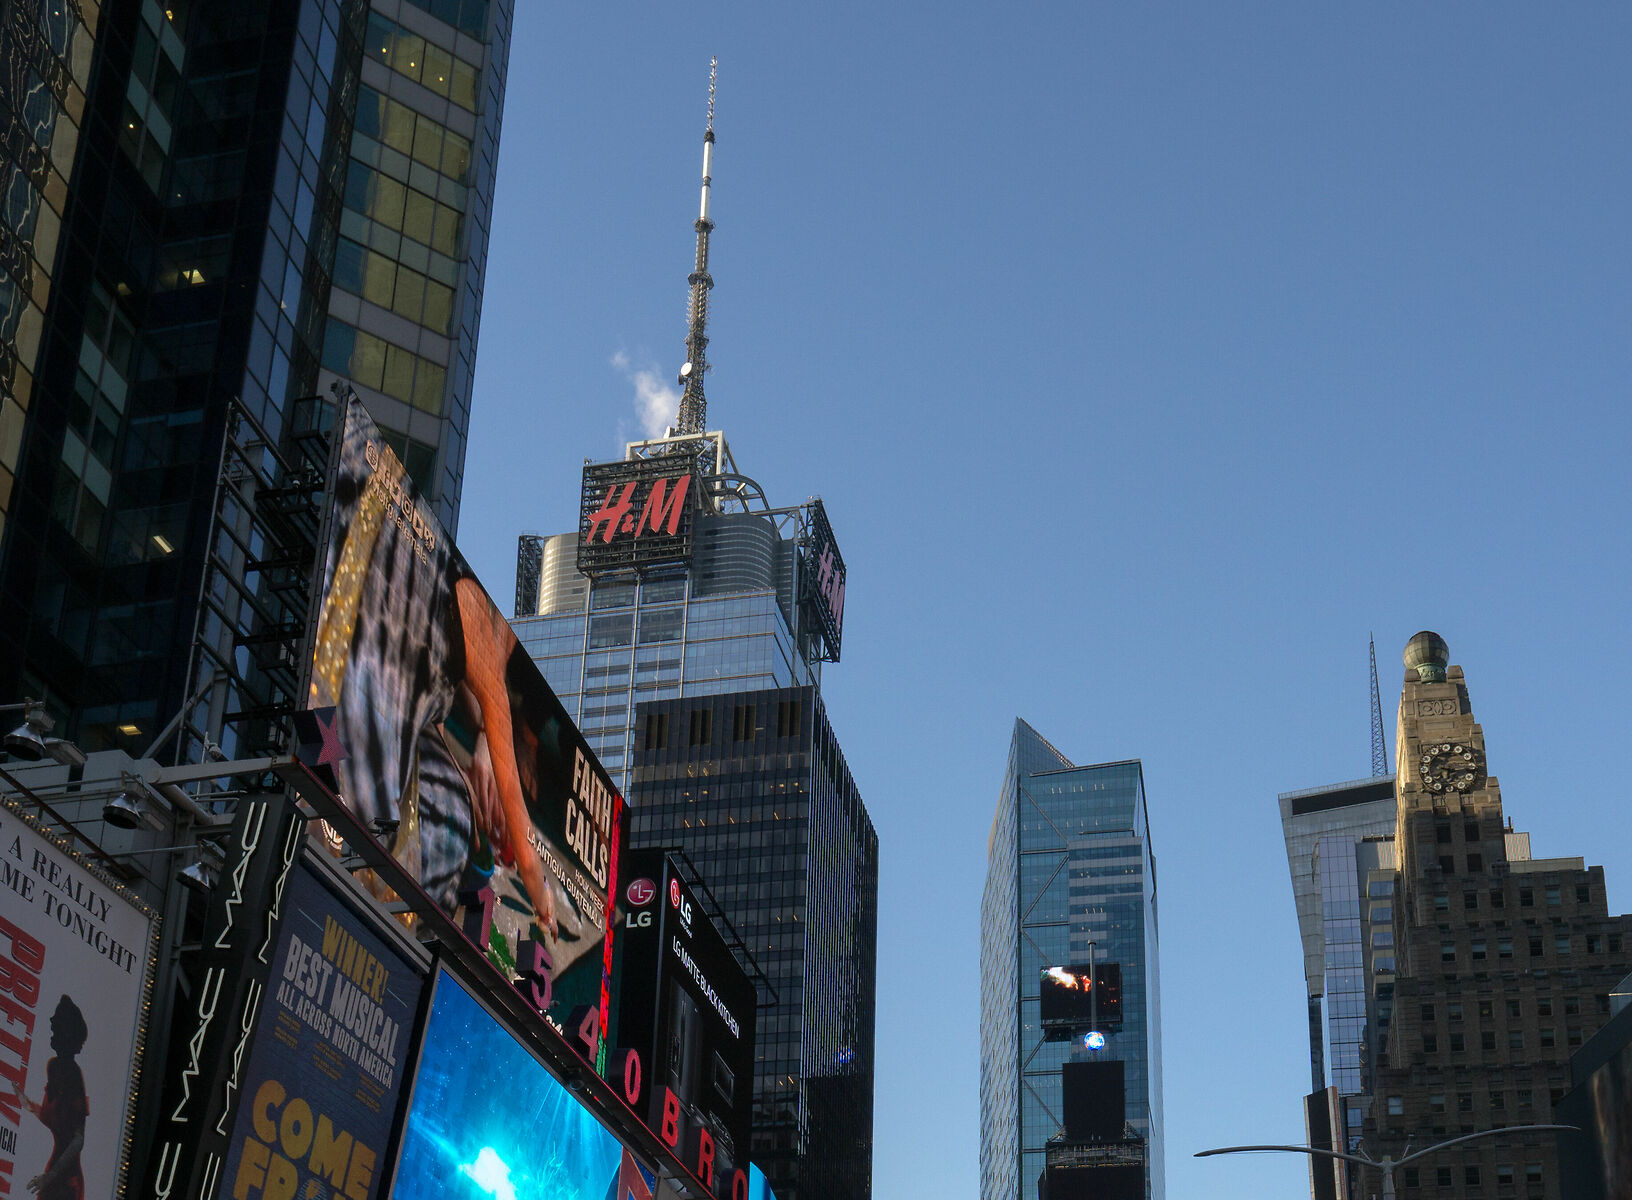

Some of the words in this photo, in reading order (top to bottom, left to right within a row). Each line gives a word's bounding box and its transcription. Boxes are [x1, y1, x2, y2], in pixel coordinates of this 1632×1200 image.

[586, 474, 691, 544] H&M
[817, 541, 845, 634] H&M
[573, 745, 612, 838] FAITH
[8, 835, 23, 862] A
[32, 848, 112, 923] REALLY
[526, 827, 537, 846] LA
[536, 841, 567, 888] ANTIGUA
[566, 879, 603, 932] GUATEMALA
[565, 797, 608, 890] CALLS
[43, 890, 137, 974] TONIGHT
[575, 869, 590, 894] HOLY
[589, 889, 605, 916] WEEK
[626, 911, 651, 929] LG
[680, 894, 692, 925] LG
[283, 934, 333, 1006] BEST
[329, 974, 399, 1067] MUSICAL
[321, 914, 389, 1006] WINNER!
[672, 935, 681, 957] LG
[681, 947, 700, 985] MATTE
[700, 975, 718, 1009] BLACK
[717, 998, 740, 1039] KITCHEN
[276, 981, 293, 1012] ALL
[295, 996, 332, 1039] ACROSS
[332, 1025, 360, 1065] NORTH
[358, 1046, 394, 1089] AMERICA
